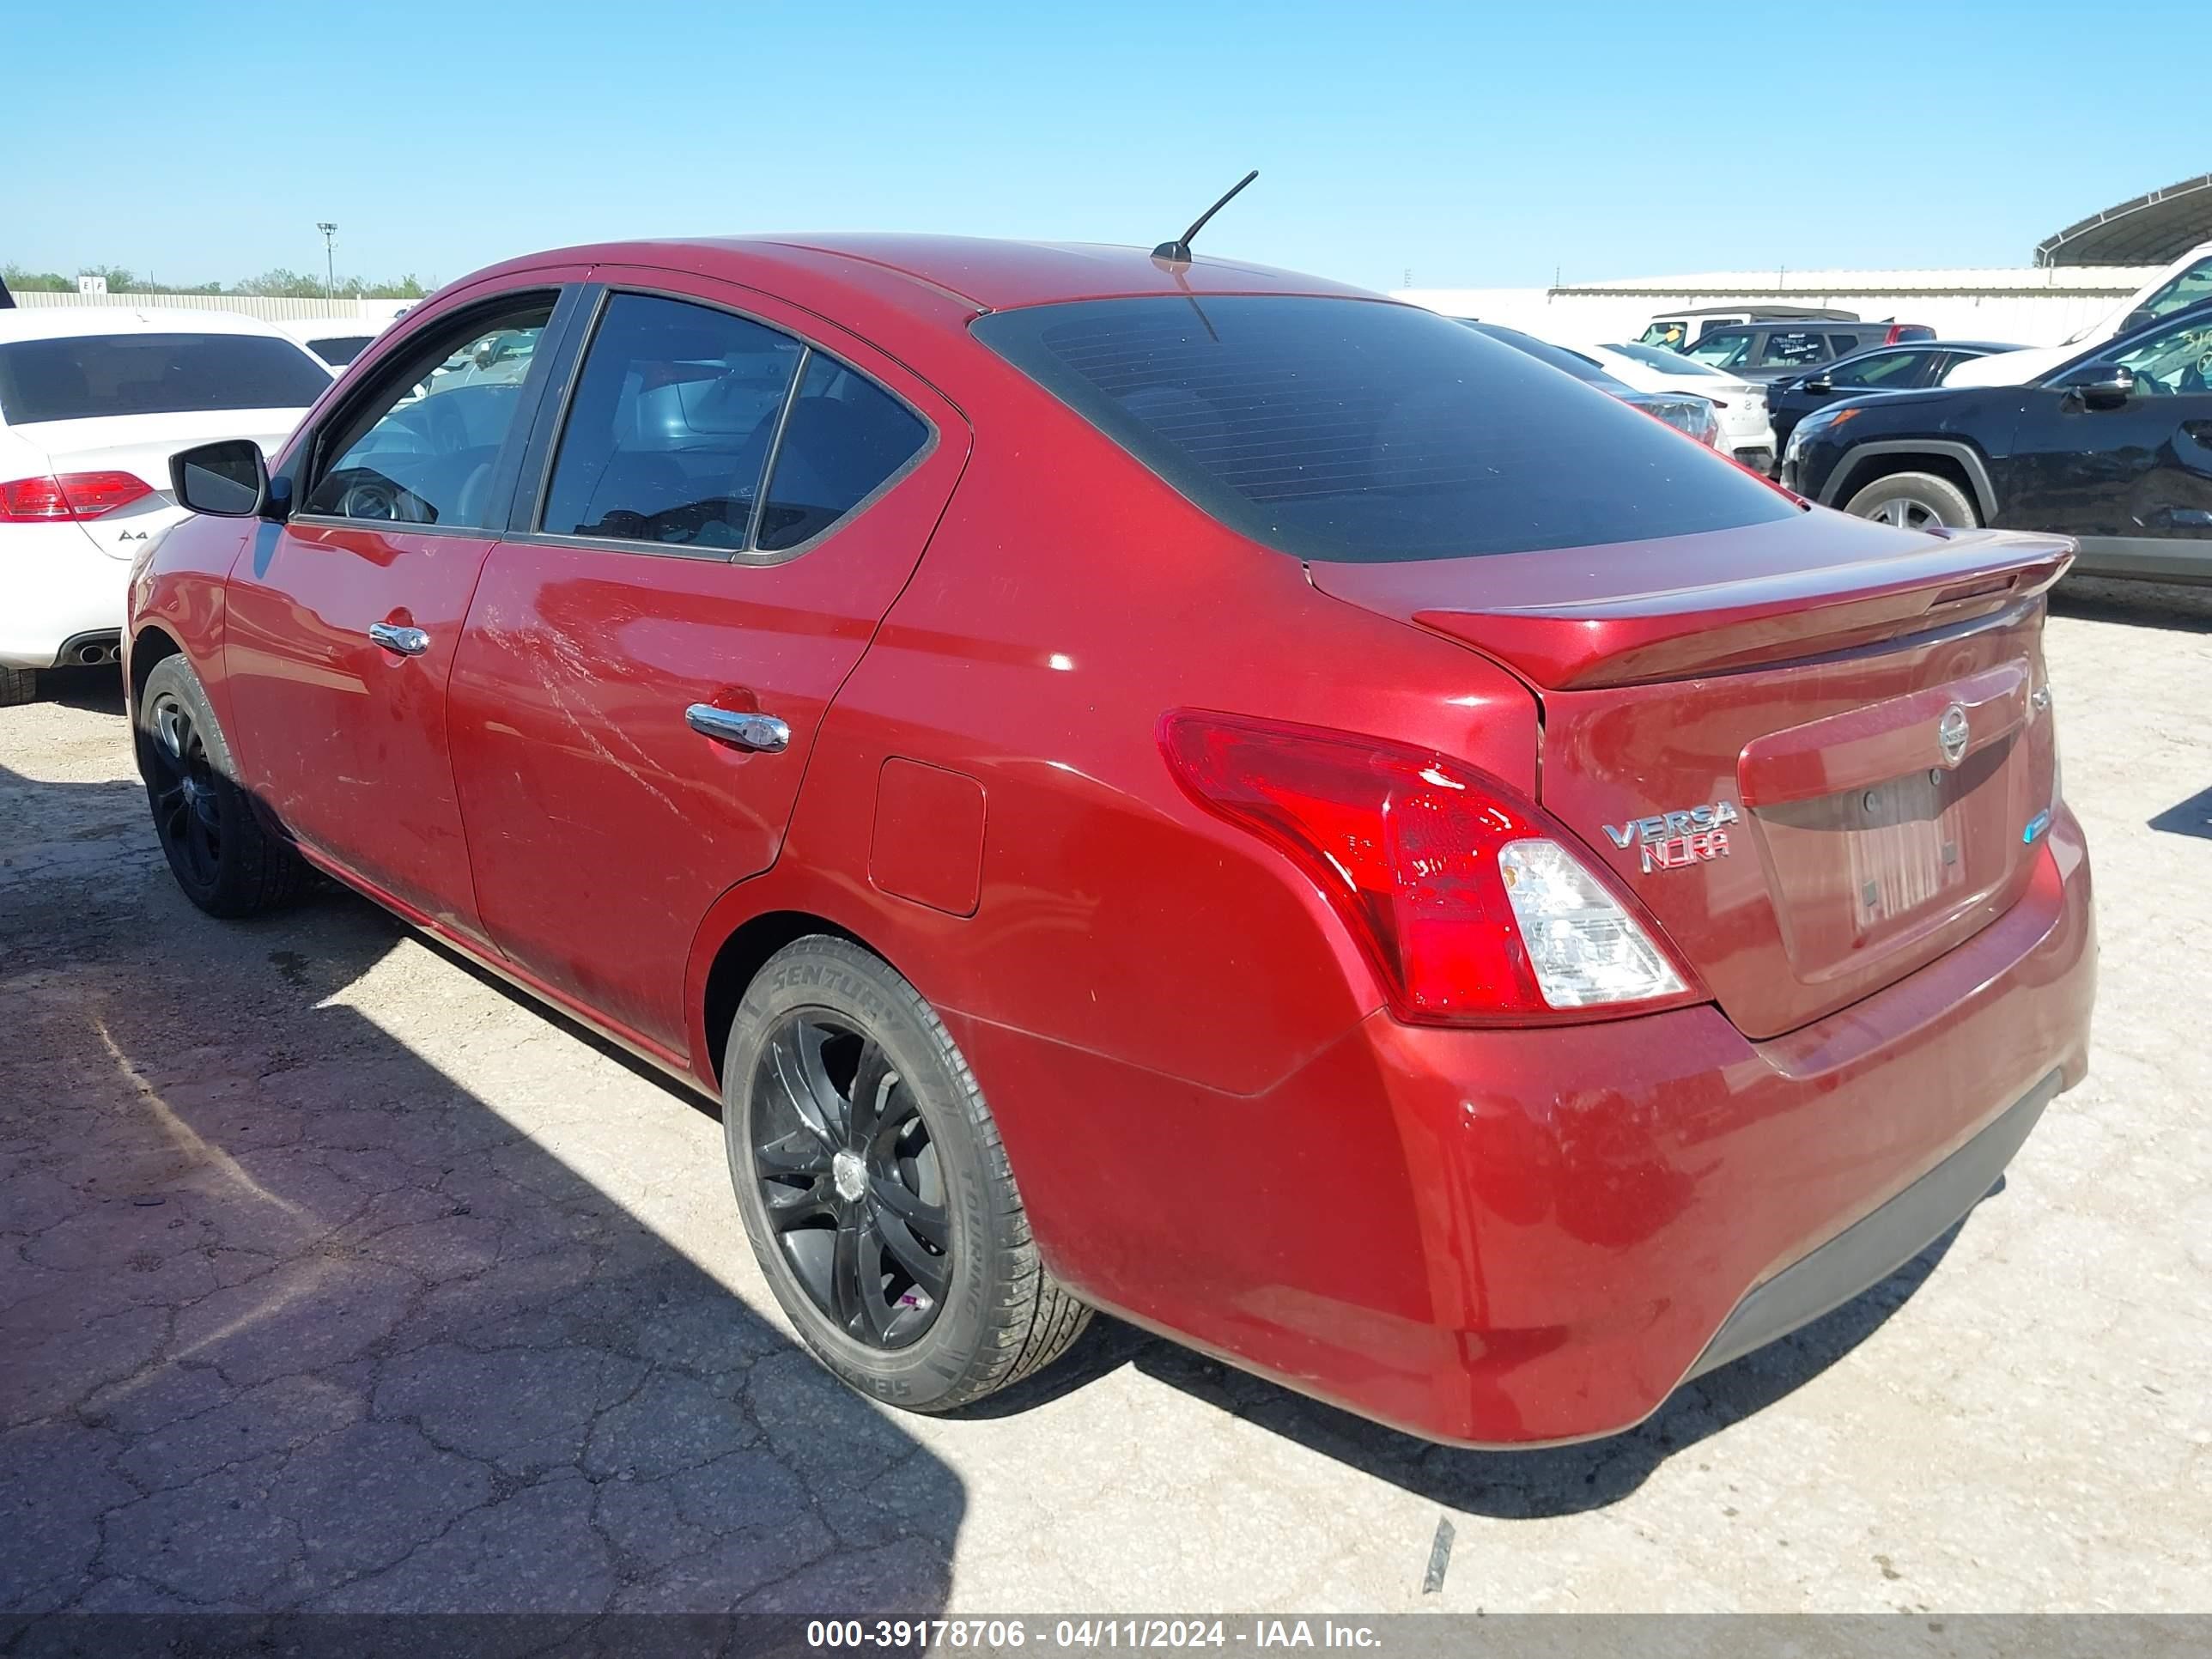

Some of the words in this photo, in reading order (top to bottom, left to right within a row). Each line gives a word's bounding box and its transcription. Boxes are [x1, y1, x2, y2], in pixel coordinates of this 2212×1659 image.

[118, 529, 149, 542] A4
[1601, 800, 1739, 849] VERSA
[1640, 829, 1730, 875] NORA
